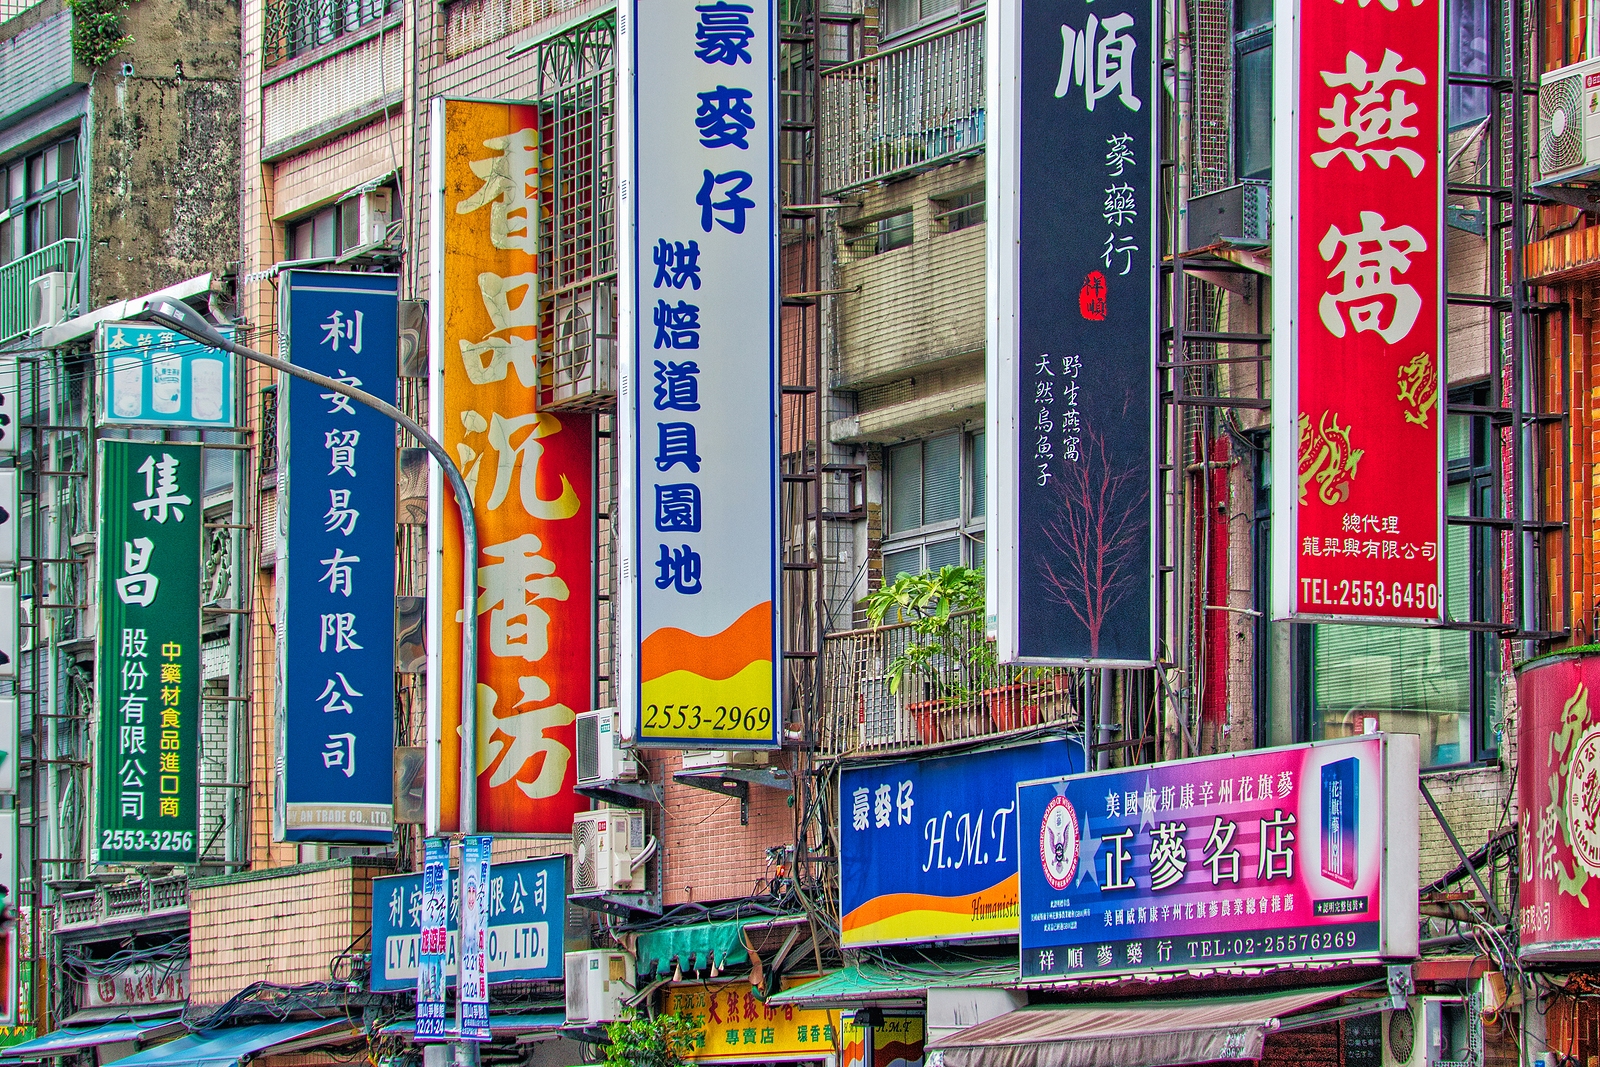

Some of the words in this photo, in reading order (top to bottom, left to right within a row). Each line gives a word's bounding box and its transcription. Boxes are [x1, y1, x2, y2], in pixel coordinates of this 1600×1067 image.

[1055, 0, 1142, 112] 順
[695, 1, 756, 234] 豪麥仔
[1310, 0, 1427, 344] 燕窩
[1100, 132, 1139, 276] 蔘藥行
[1083, 273, 1106, 317] 祥順
[109, 328, 215, 358] 本草第一
[653, 238, 702, 594] 烘焙道具園地
[1034, 353, 1055, 487] 天然烏魚子
[1062, 354, 1083, 462] 野生燕窩
[115, 453, 192, 608] 集昌
[316, 310, 365, 779] 利安貿易有限公司
[1342, 513, 1400, 534] 總代理
[1301, 577, 1437, 609] TEL:2553-6450
[118, 628, 149, 821] 股份有限公司
[159, 641, 181, 818] 中藥材食品進口商
[644, 704, 771, 733] 2553-2969
[316, 810, 346, 823] TRADE
[371, 811, 390, 824] LTD.
[853, 780, 914, 831] 豪麥仔
[1106, 771, 1293, 819] 美國威斯康辛州花旗蔘
[102, 829, 193, 851] 2553-3256
[922, 800, 1015, 873] H.M.T
[1100, 808, 1297, 893] 正蔘名店
[1574, 818, 1588, 852] KIM
[1588, 845, 1600, 860] HI
[388, 869, 547, 927] 利安易限公司
[389, 938, 404, 969] LY
[489, 930, 507, 960] O.,
[514, 927, 544, 958] LTD.
[1039, 940, 1172, 971] 祥順蔘藥行
[1187, 931, 1357, 958] TEL:02-25576269
[726, 1027, 774, 1045] 專賣店
